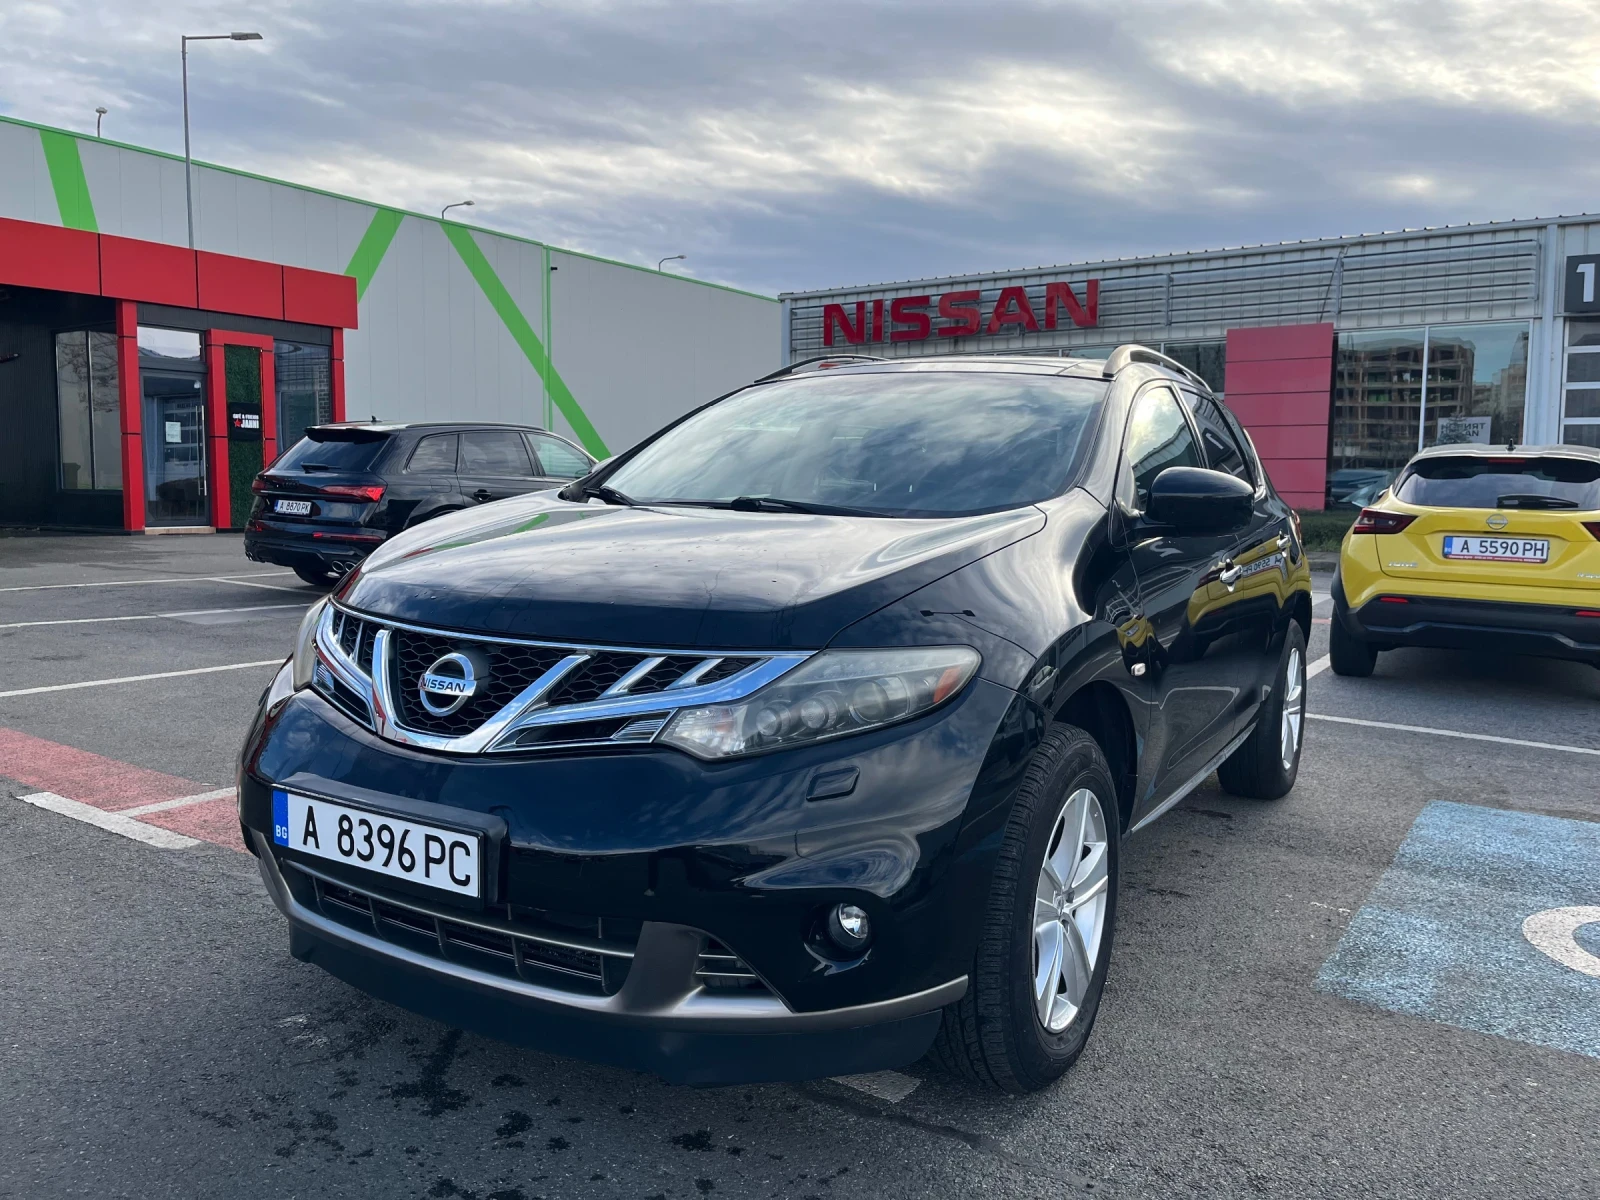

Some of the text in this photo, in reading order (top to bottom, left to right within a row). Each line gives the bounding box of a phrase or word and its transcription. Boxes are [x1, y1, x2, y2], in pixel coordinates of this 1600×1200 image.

[1576, 263, 1595, 302] 1
[823, 279, 1099, 346] NISSAN
[1460, 539, 1545, 557] A 5590 PH
[421, 677, 466, 693] NISSAN
[275, 824, 288, 839] BG
[302, 805, 471, 886] A 8396 PC
